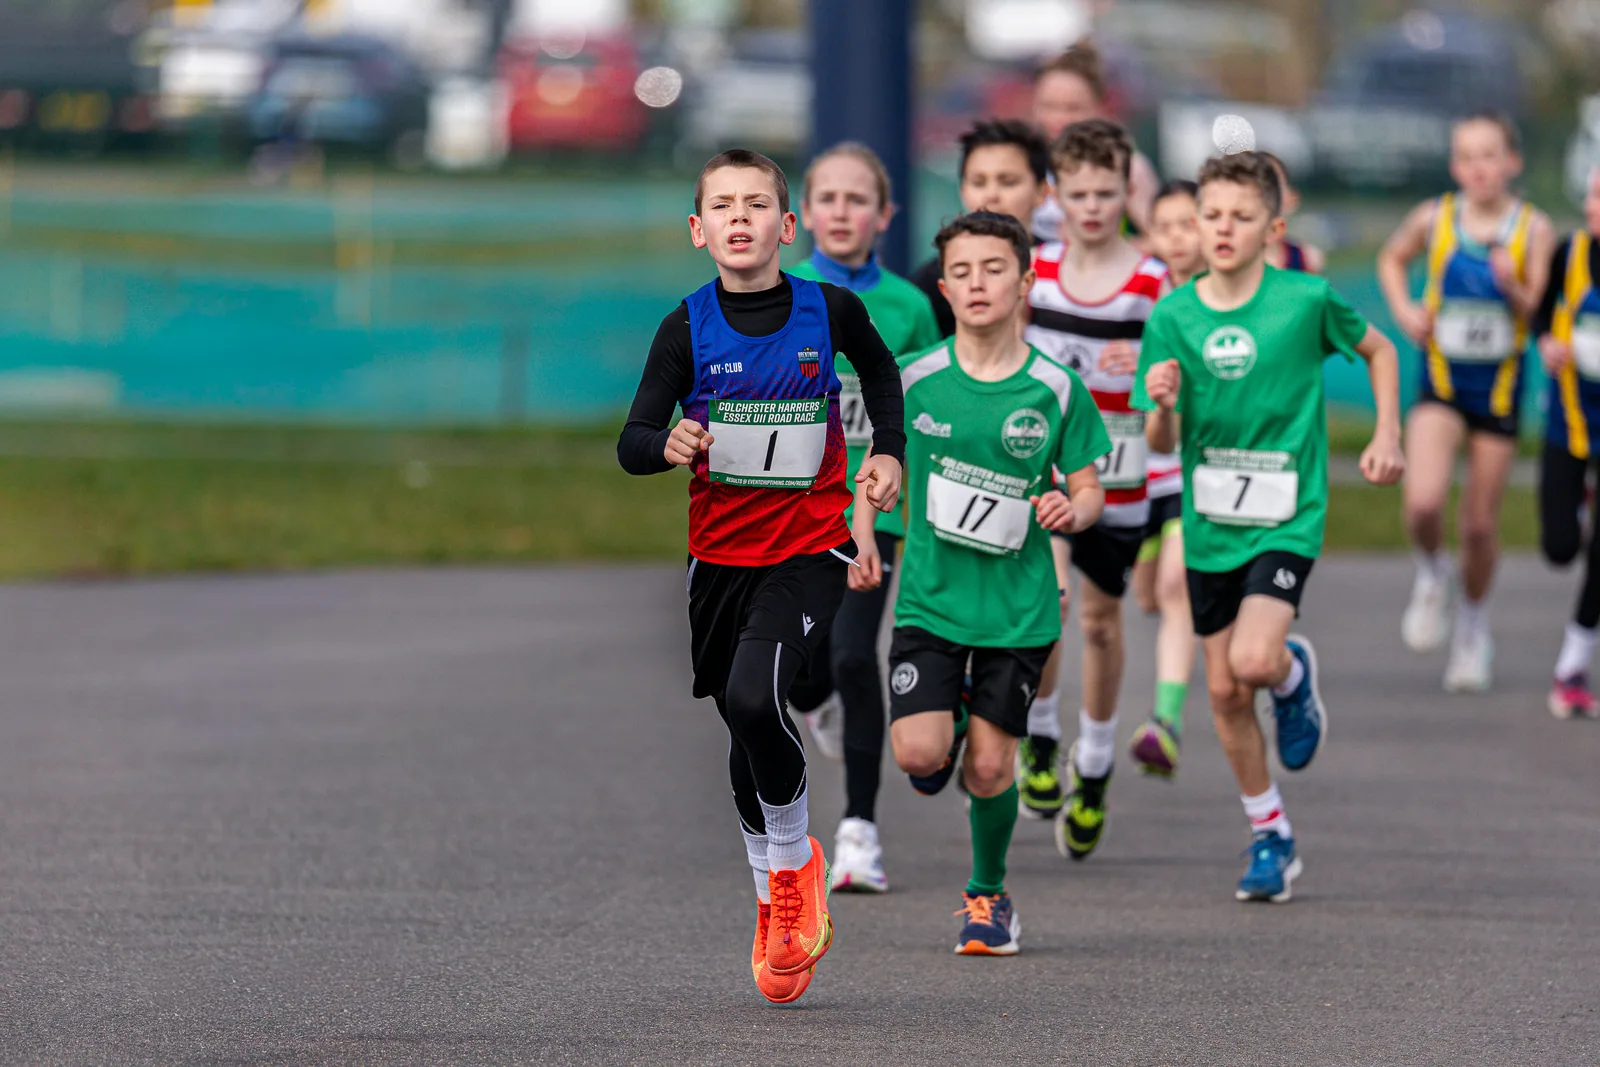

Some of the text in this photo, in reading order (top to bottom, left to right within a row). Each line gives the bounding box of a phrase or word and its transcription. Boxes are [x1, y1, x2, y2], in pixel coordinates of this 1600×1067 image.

[718, 401, 820, 413] COLCHESTER HARRIERS
[723, 412, 752, 423] ESSEX
[767, 413, 792, 423] ROAD
[793, 412, 816, 423] RACE
[763, 430, 778, 471] 1
[1233, 475, 1252, 511] 7
[957, 494, 1000, 533] 17
